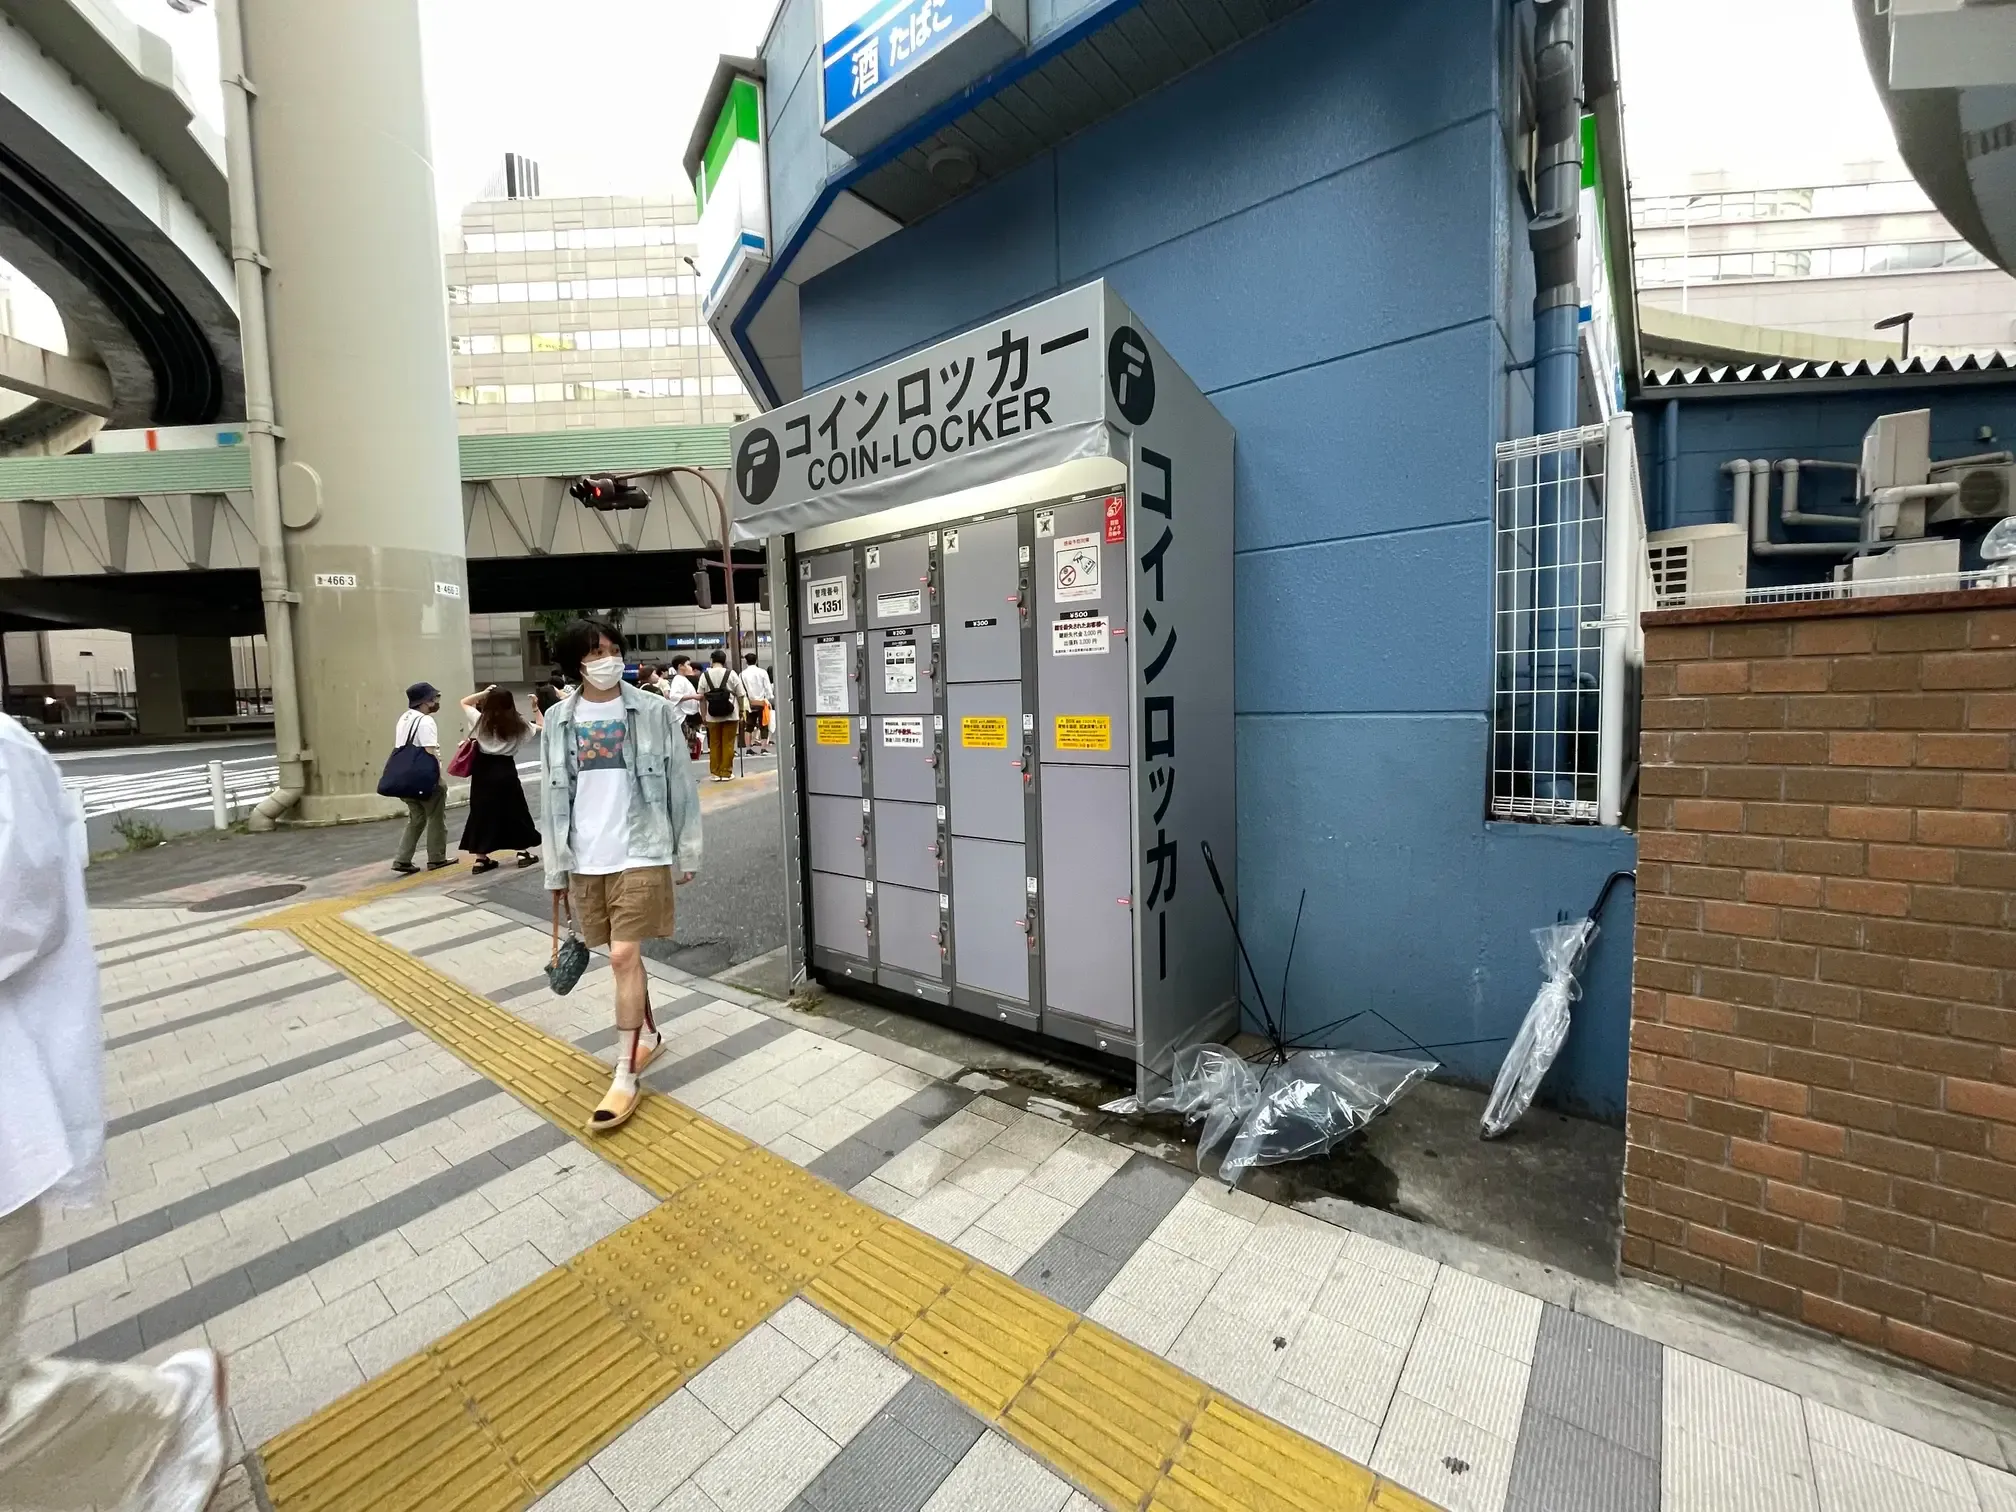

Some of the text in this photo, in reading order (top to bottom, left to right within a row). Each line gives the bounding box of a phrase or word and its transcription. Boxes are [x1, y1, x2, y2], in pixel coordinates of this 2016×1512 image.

[852, 0, 953, 98] 酒 たばこ
[785, 327, 1090, 459] コインロッカー
[808, 386, 1053, 491] COIN-LOCKER
[813, 599, 842, 615] K-1351
[1140, 446, 1178, 981] コインロッカー
